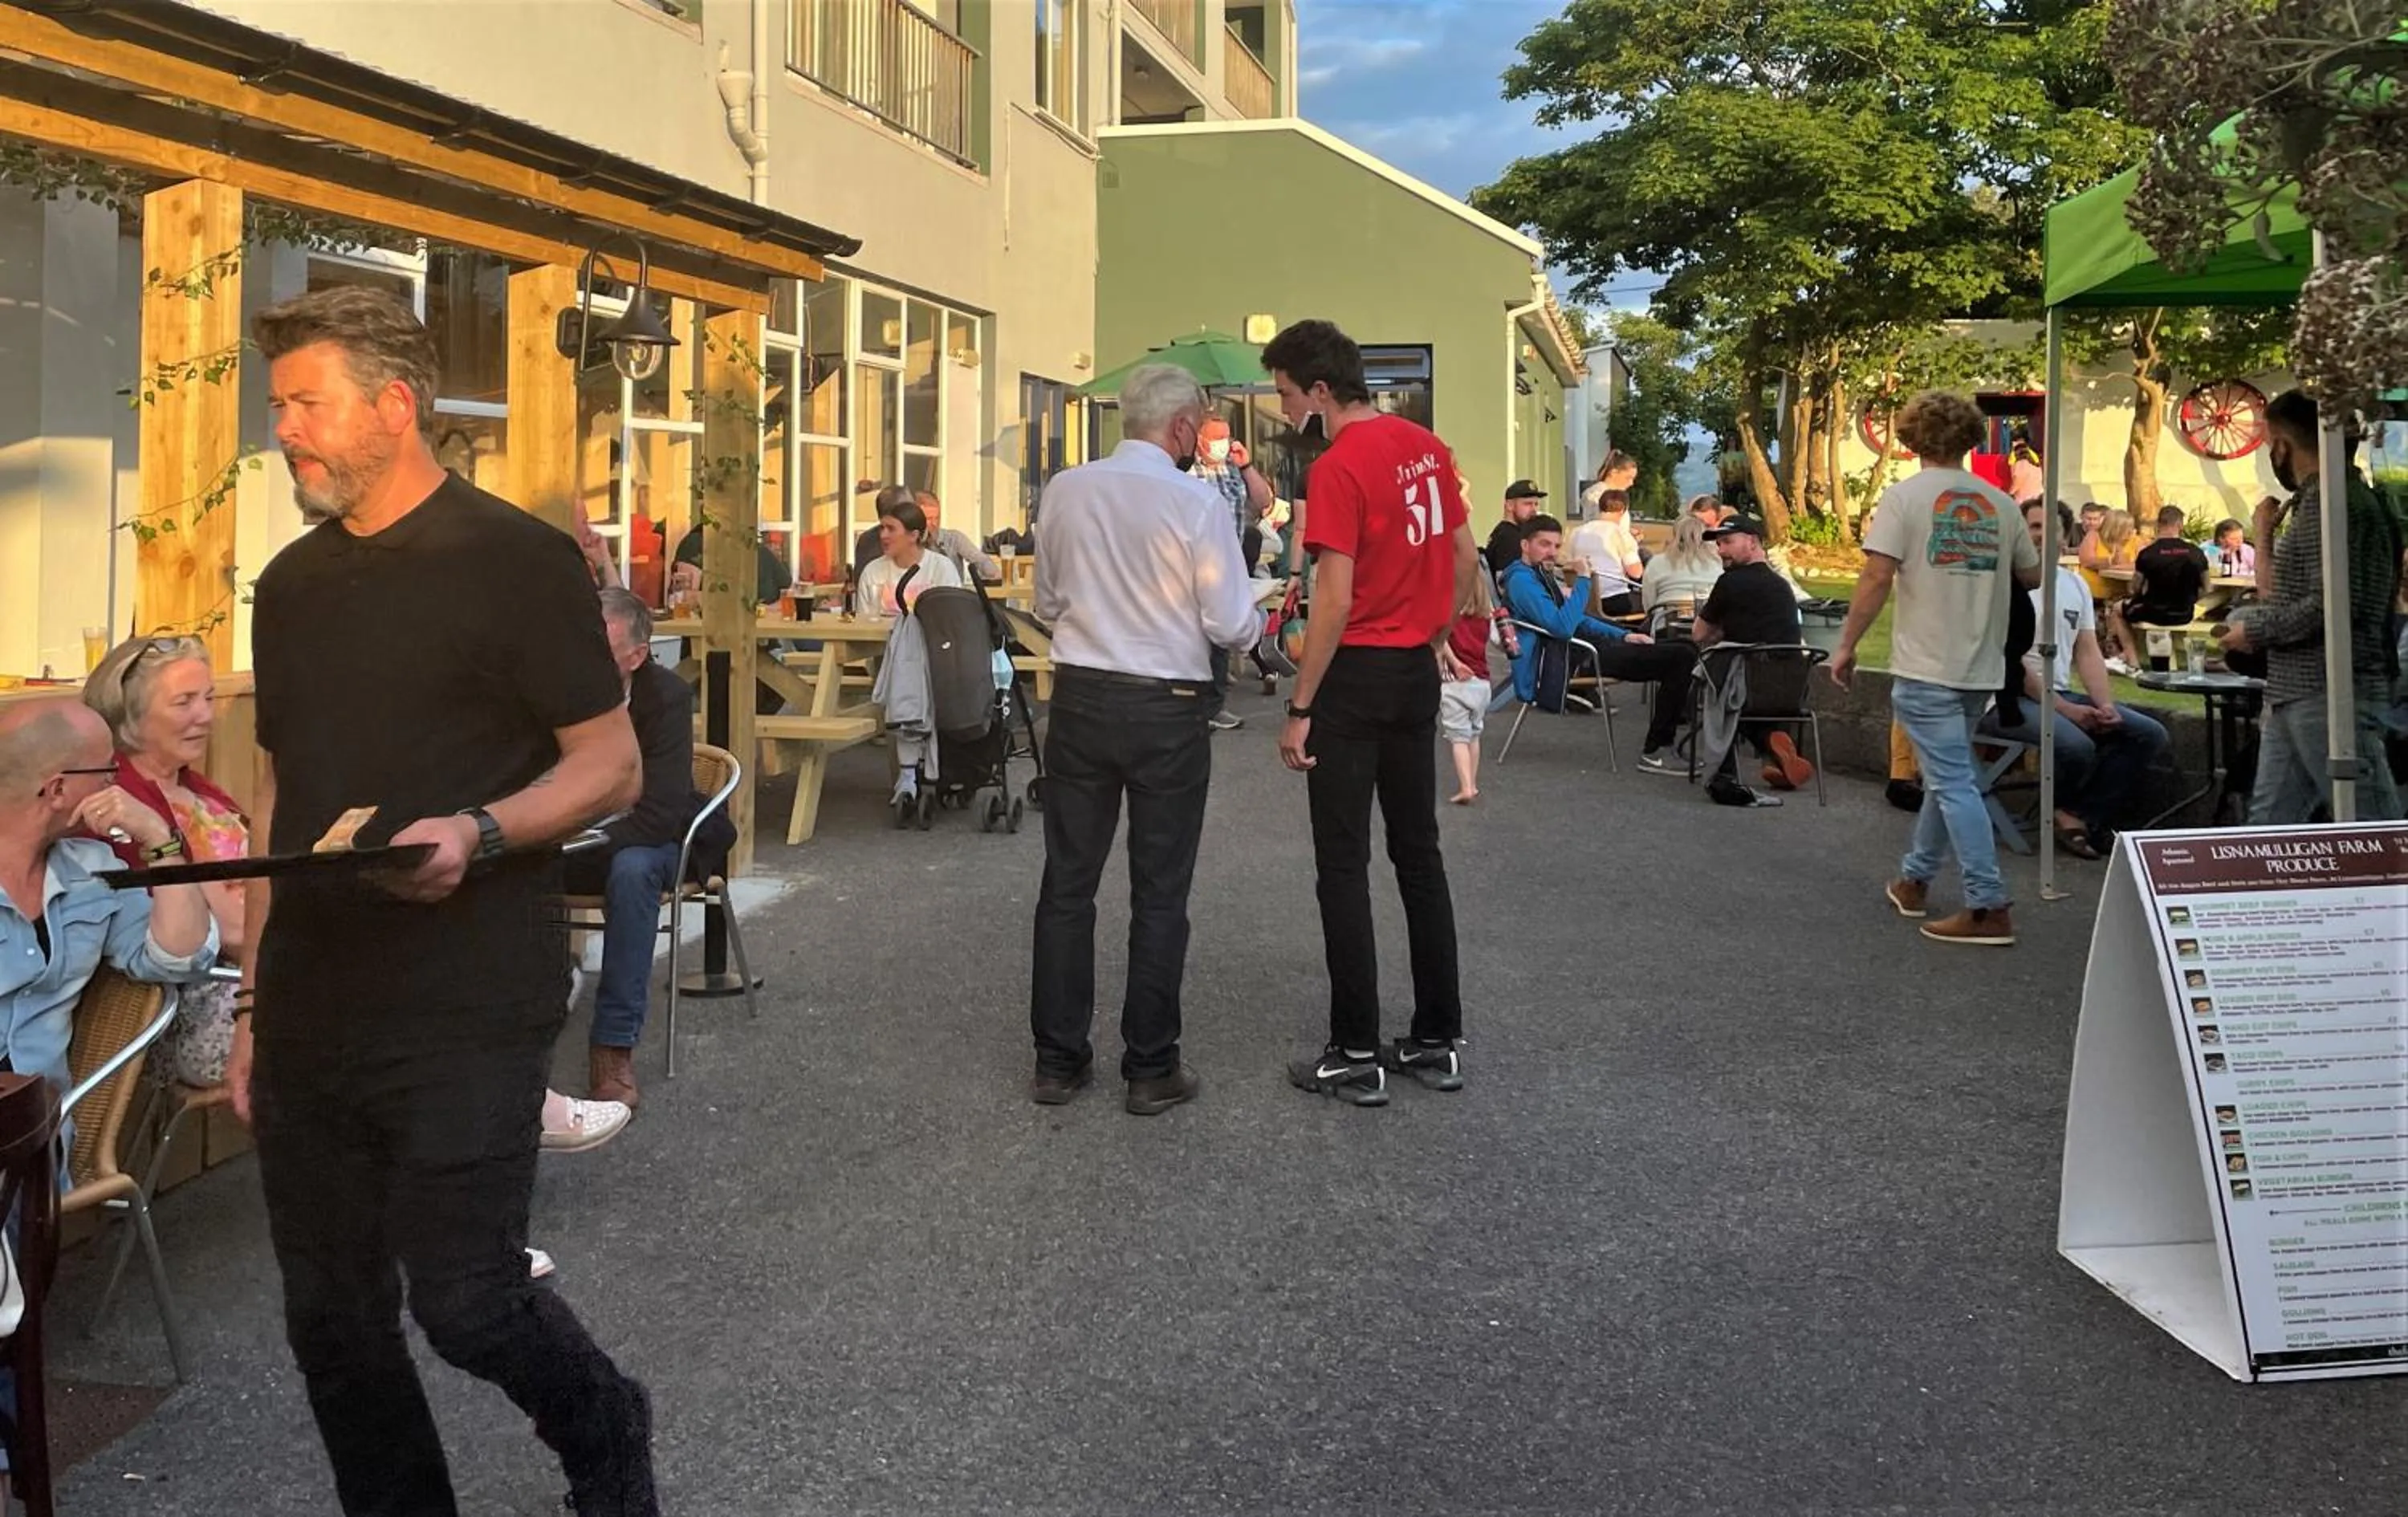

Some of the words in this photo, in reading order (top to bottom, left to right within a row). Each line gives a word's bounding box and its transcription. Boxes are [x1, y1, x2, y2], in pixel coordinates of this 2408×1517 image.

[1404, 476, 1445, 547] 51
[2211, 841, 2332, 860] LISNAMULLIGAN
[2337, 839, 2384, 854] FARM
[2265, 856, 2341, 873] PRODUCE
